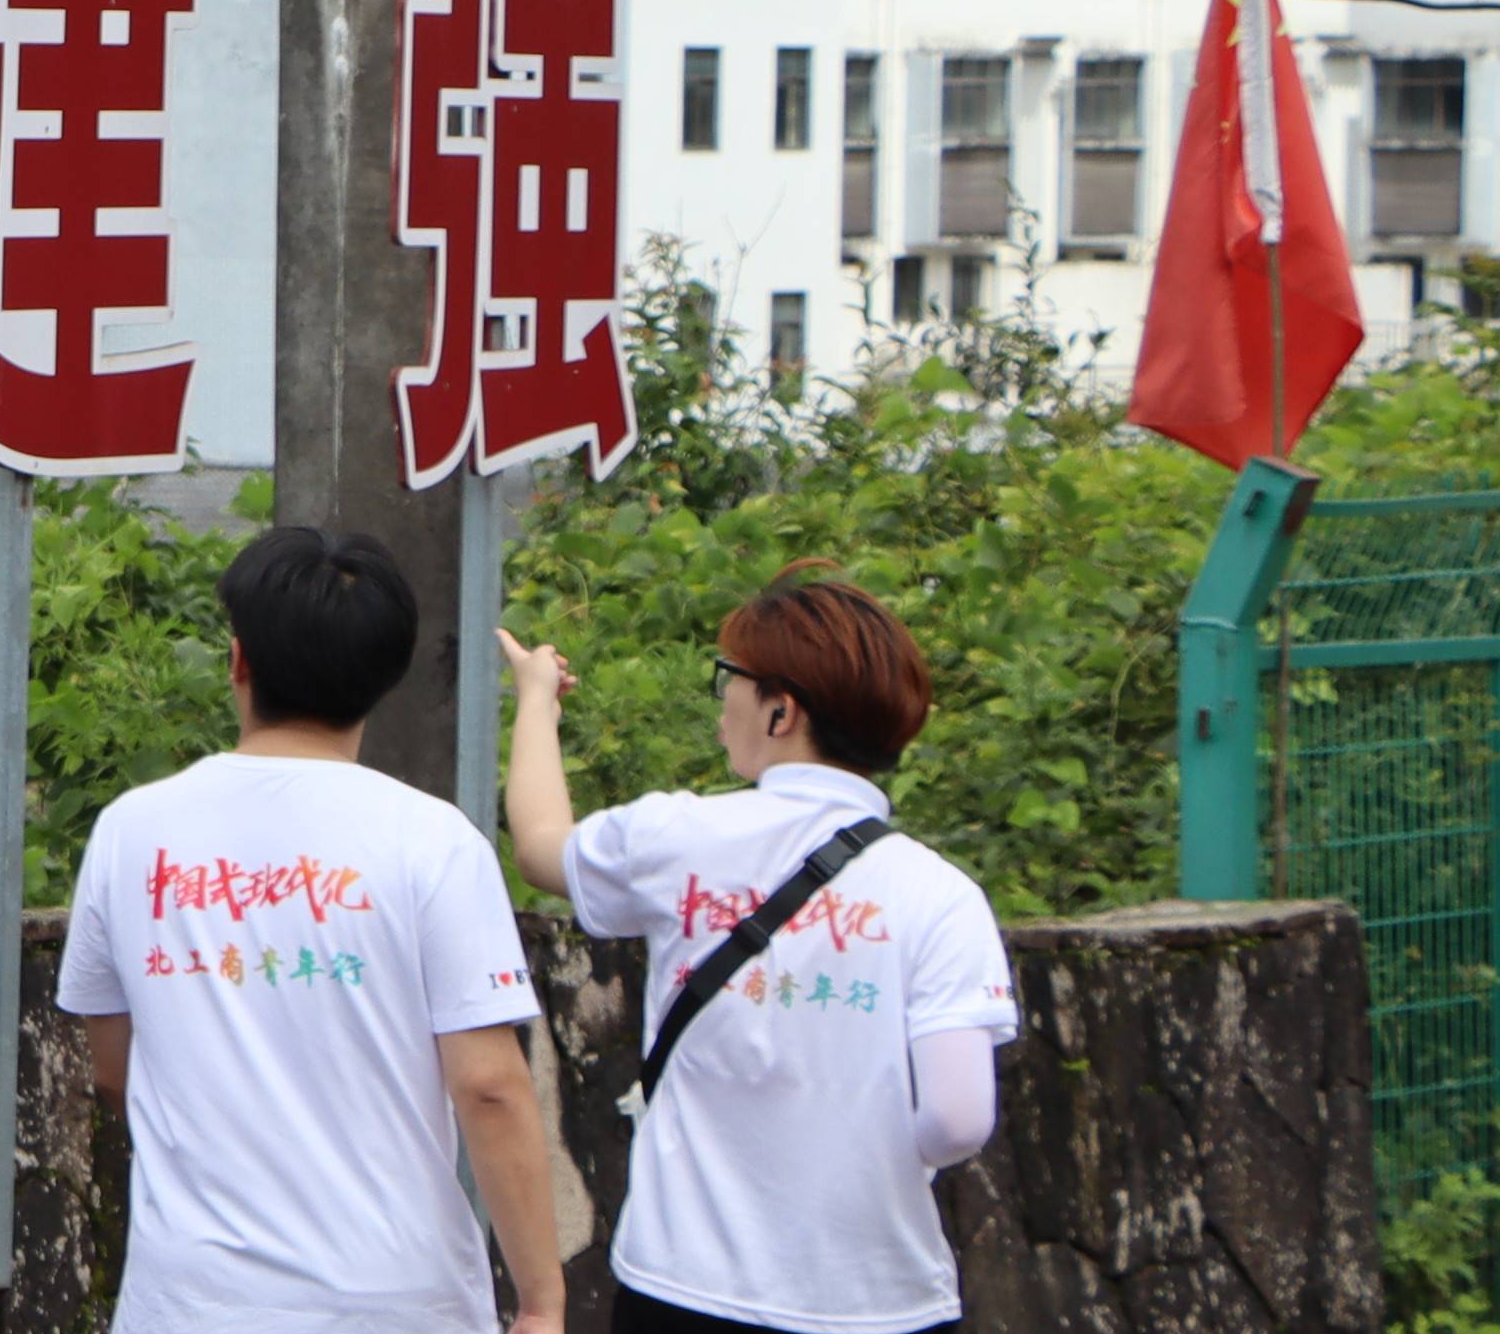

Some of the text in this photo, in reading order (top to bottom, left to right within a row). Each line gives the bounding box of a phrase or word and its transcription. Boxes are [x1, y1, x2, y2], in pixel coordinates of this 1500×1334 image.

[146, 848, 373, 924] 中国式现代化
[145, 941, 365, 988] 北工商青年行
